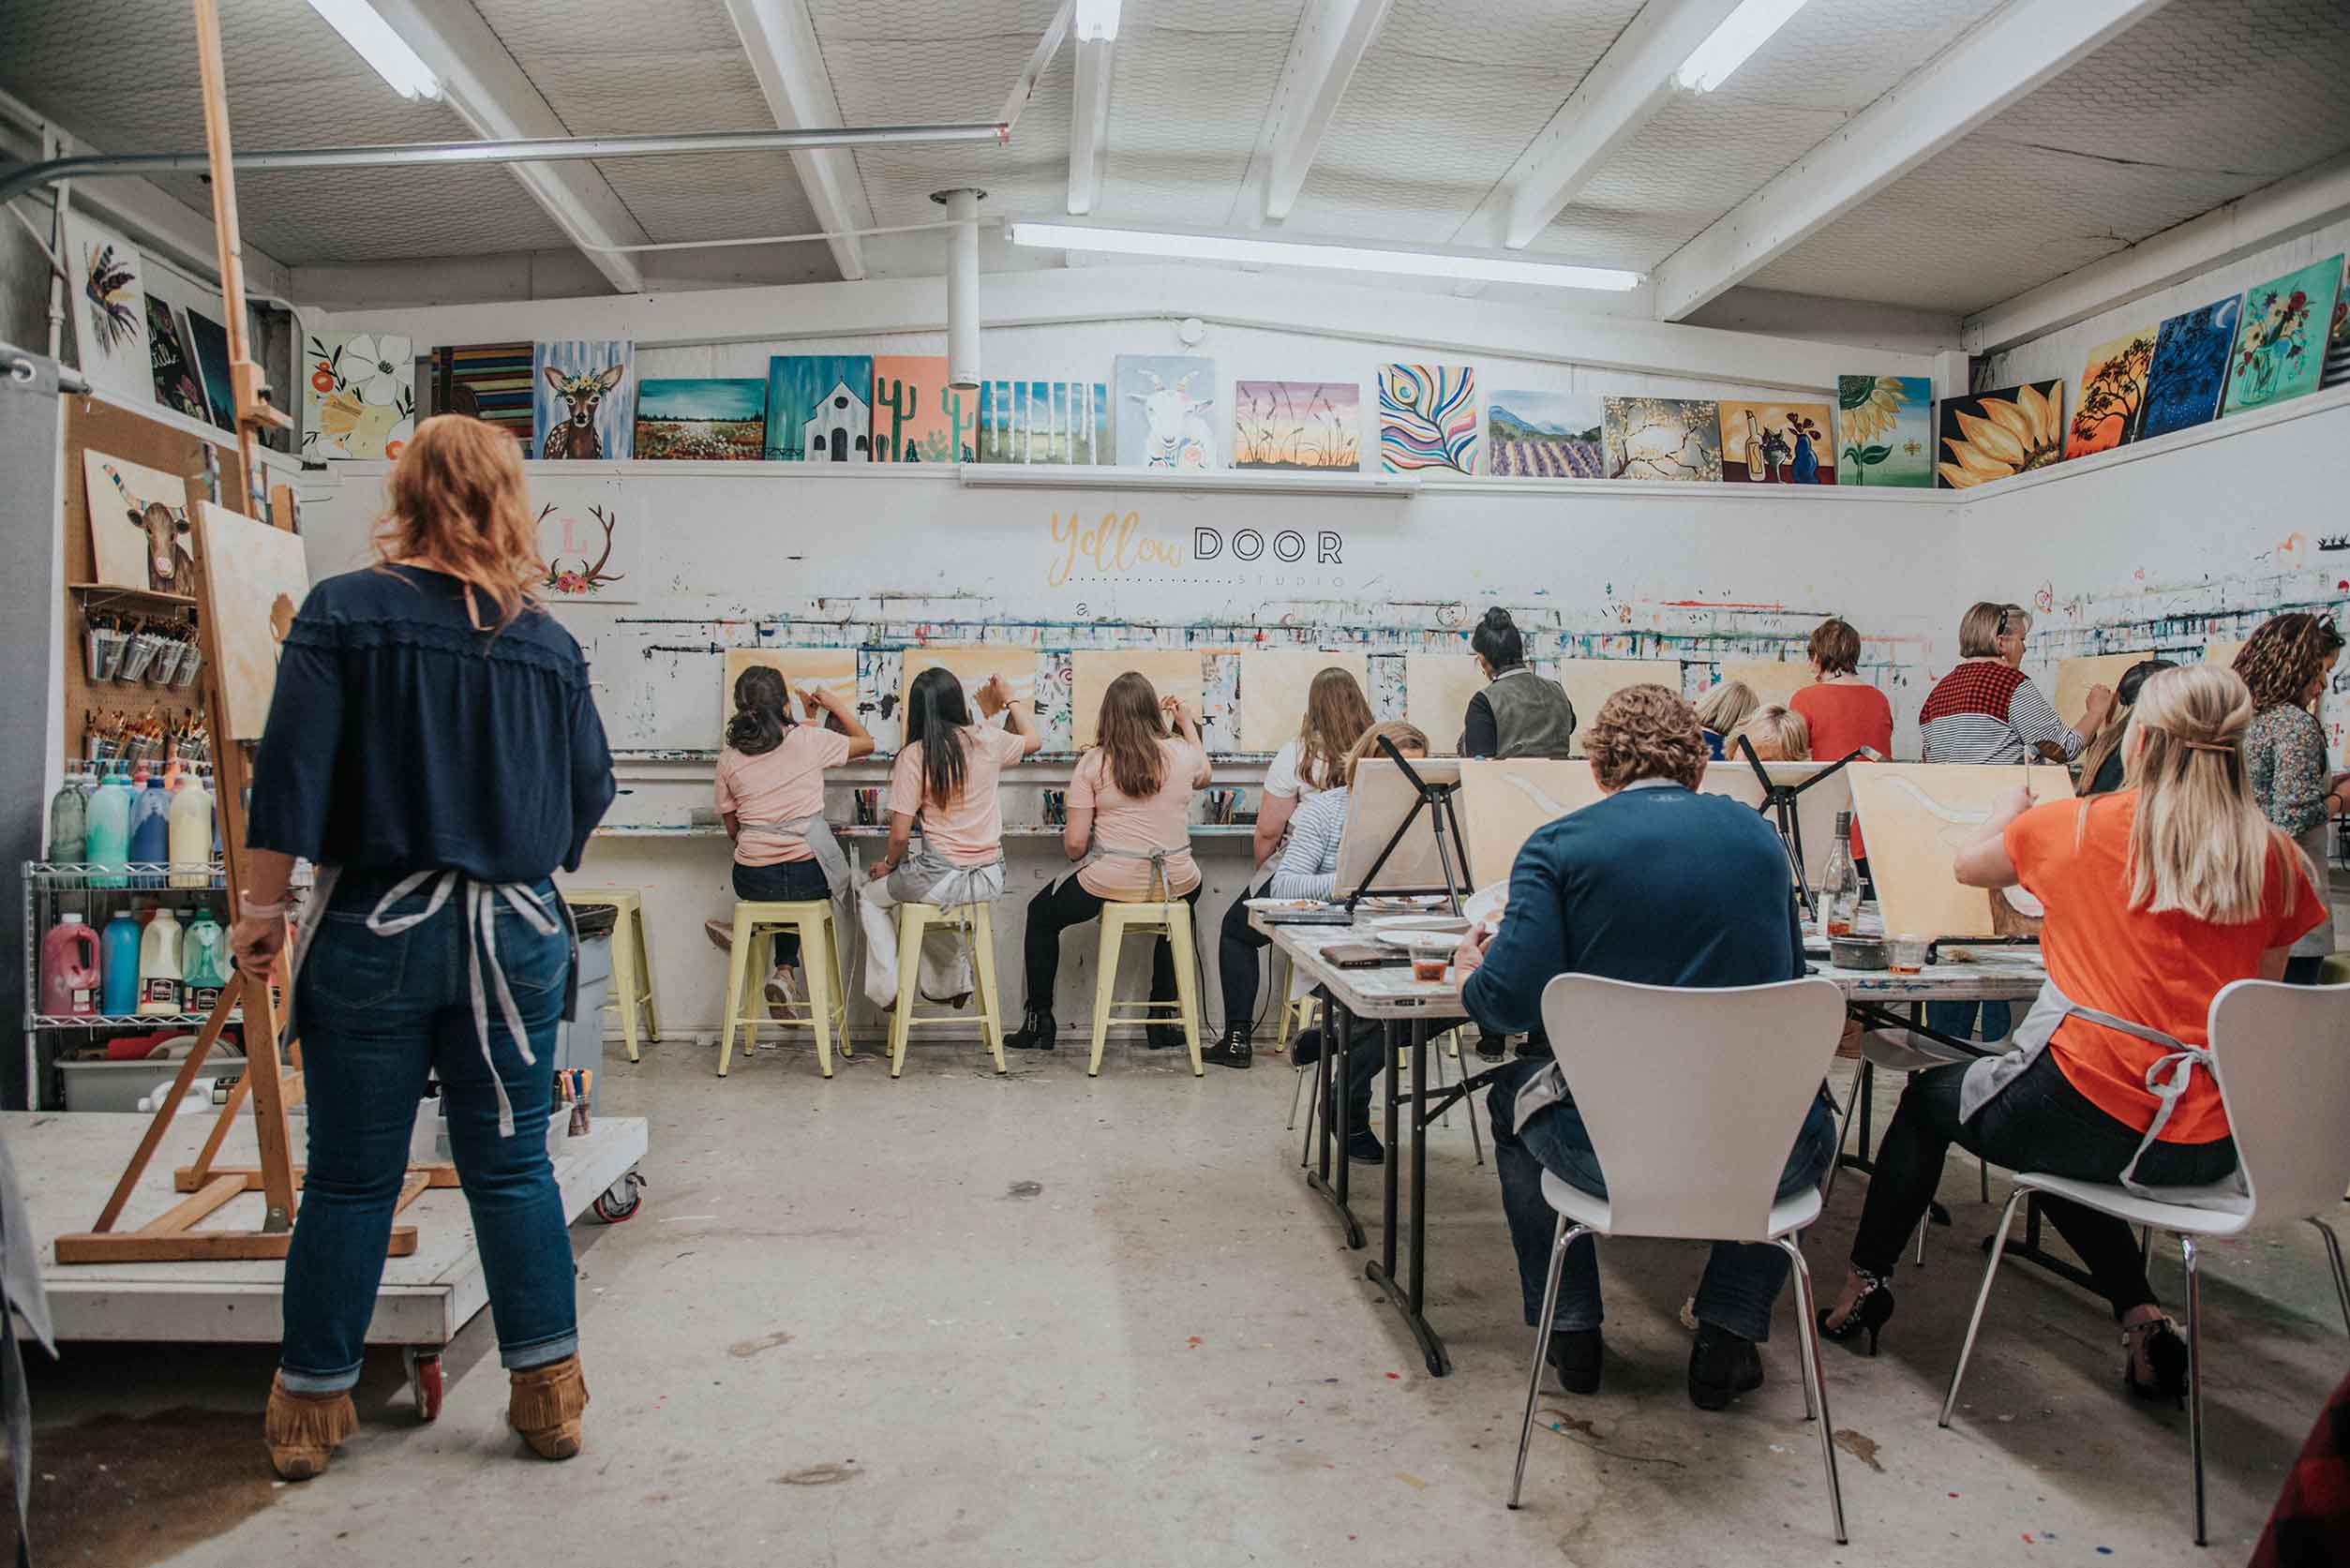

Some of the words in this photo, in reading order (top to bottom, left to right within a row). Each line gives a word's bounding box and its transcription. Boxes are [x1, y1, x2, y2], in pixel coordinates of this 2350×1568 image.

[561, 517, 589, 555] L
[1194, 527, 1342, 563] DOOR
[1237, 575, 1344, 586] STUDIO
